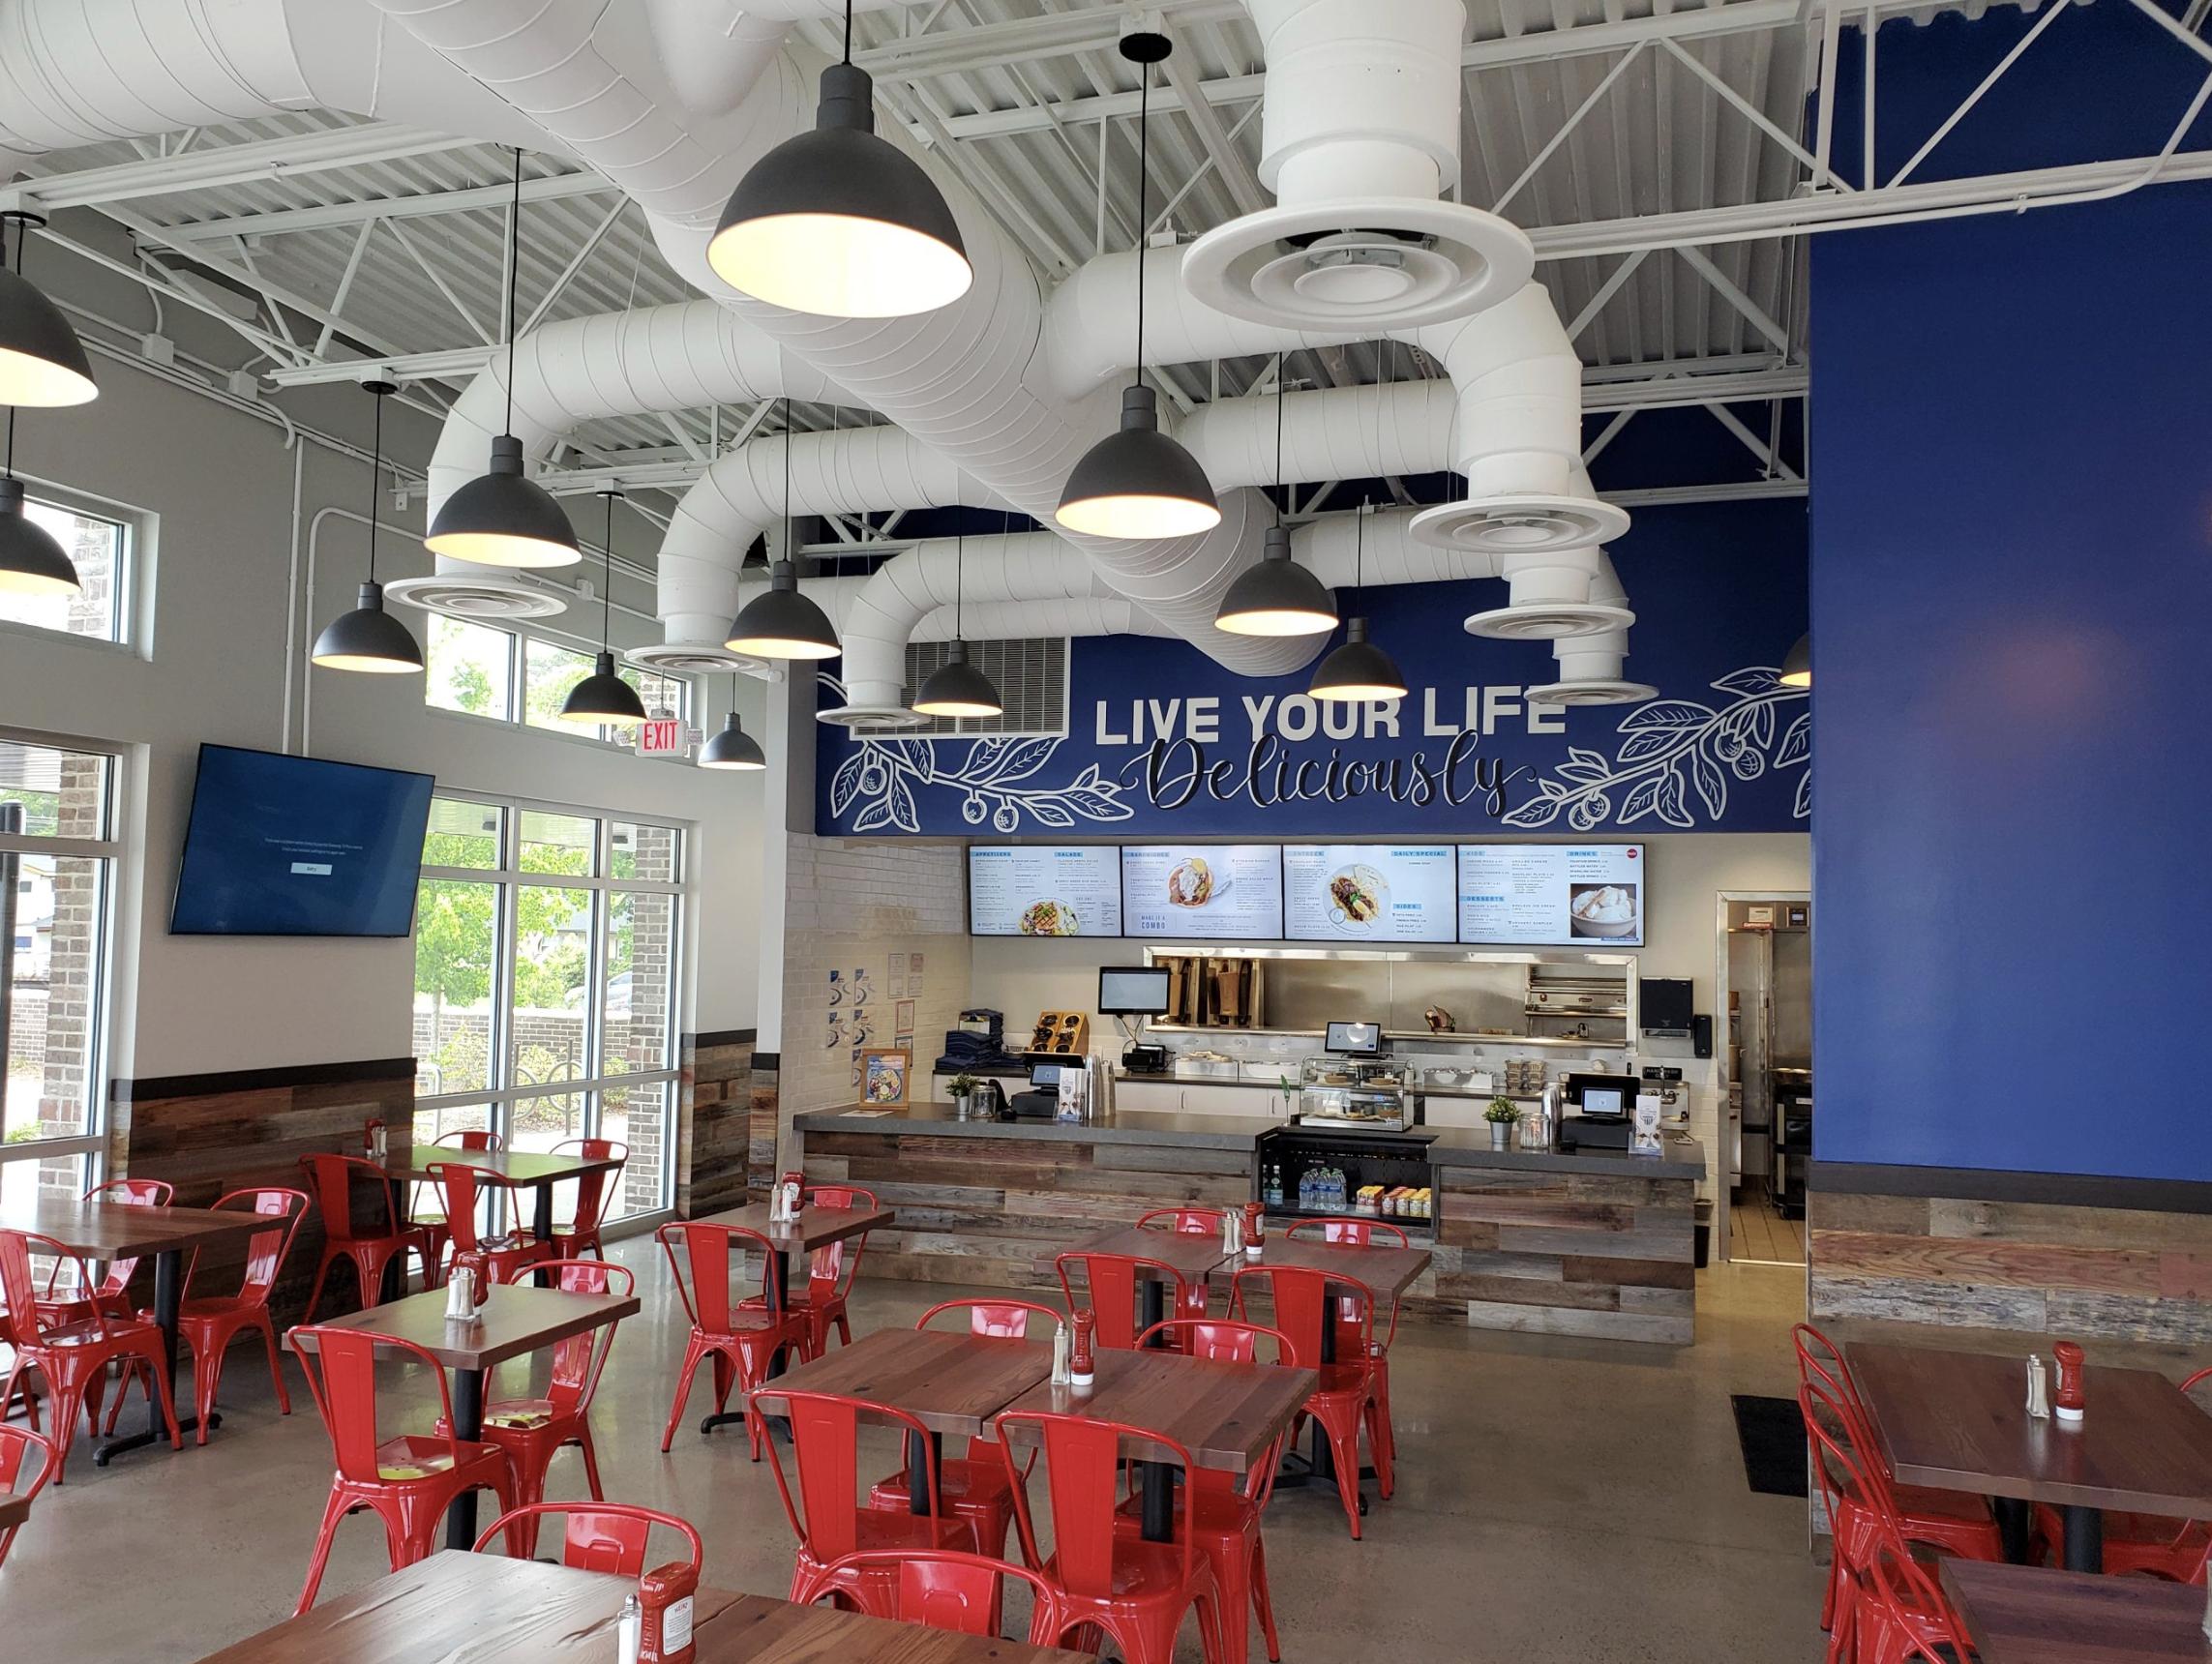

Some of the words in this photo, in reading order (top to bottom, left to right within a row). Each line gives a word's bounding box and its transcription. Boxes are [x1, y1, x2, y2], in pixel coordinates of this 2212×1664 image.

[1096, 696, 1220, 745] LIVE
[1241, 694, 1400, 742] YOUR
[1423, 686, 1567, 737] LIFE
[643, 722, 677, 750] EXIT
[1120, 729, 1537, 817] Deliciously
[1141, 921, 1166, 930] COMBO
[674, 1602, 688, 1614] HEINZ
